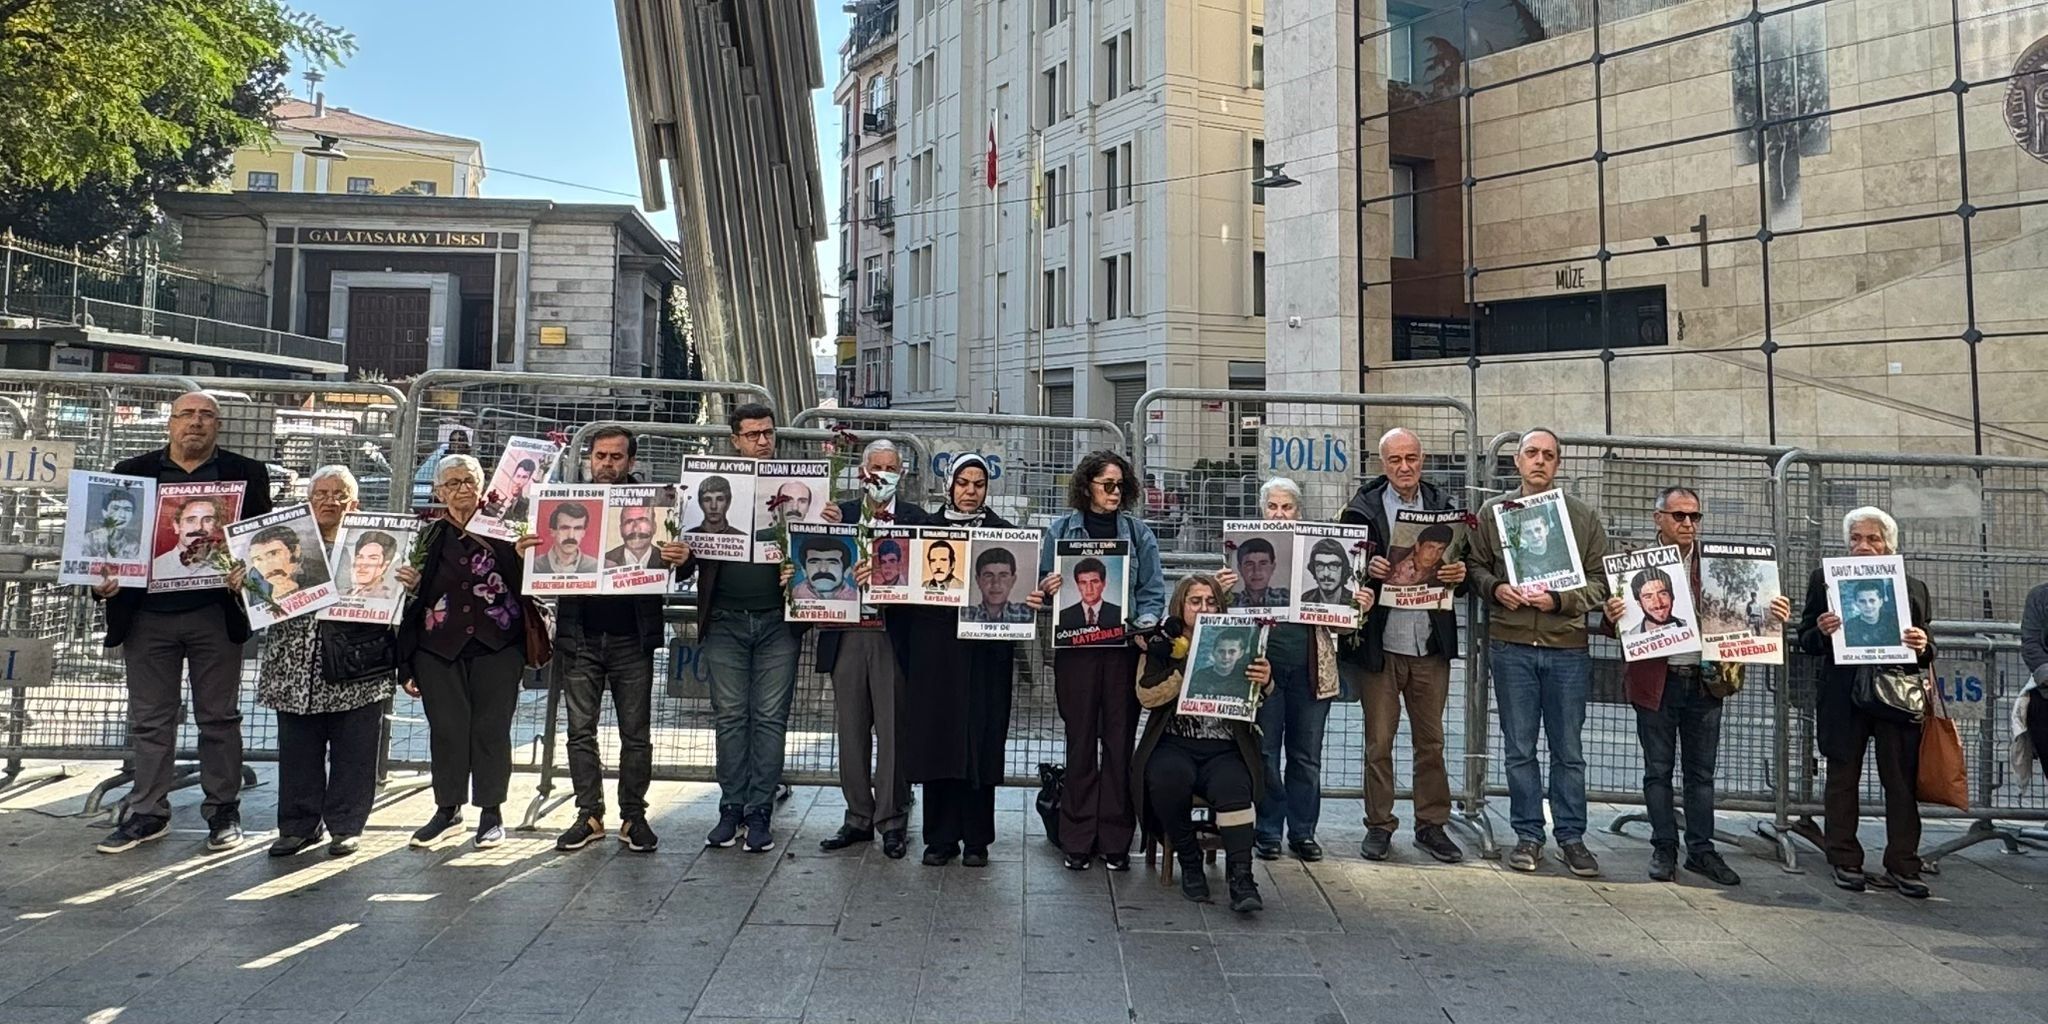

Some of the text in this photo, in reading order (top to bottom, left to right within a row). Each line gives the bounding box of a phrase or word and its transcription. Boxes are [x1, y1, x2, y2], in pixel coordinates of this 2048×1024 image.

[309, 230, 485, 246] GALATASARAY LİSESİ
[1556, 267, 1585, 290] MÜZE
[1269, 434, 1348, 472] POLİS
[0, 446, 58, 483] LİS
[687, 460, 717, 471] NEDİM
[759, 463, 828, 477] RIDVAN KARAKOÇ
[124, 479, 145, 487] EPE
[161, 483, 243, 495] KENAN BİLGİN
[573, 489, 604, 498] TOSUN
[610, 498, 643, 506] SEYHAN
[262, 508, 307, 527] KIRBAYIR
[344, 515, 417, 530] MURAT YILDIZ
[1399, 512, 1435, 522] SEYHAN
[790, 523, 858, 535] İBRAHİM DEMİR
[1263, 521, 1294, 530] DOĞAN
[1296, 525, 1365, 538] HAYRETTİN EREN
[890, 529, 910, 538] ÇELİK
[972, 530, 1039, 540] EYHAN DOĞAN
[692, 549, 743, 557] AYBEDİLDİ
[1703, 544, 1772, 556] ABDULLAH OLCAY
[1608, 549, 1679, 573] HASAN OCAK
[613, 573, 665, 589] KAYBEDİLDİ
[1395, 589, 1449, 606] KAYBEDİLDİ
[328, 606, 390, 620] KAYBEDİLDİ
[793, 609, 847, 620] KAYBEDİLDİ
[1300, 612, 1352, 624] KAYBEDİLDİ
[1056, 626, 1101, 639] GÖZALTINDA
[1072, 626, 1123, 645] KAYBEDİLDİ
[1628, 628, 1695, 658] KAYBEDİLDİ
[1719, 643, 1778, 659] KAYBEDİLDİ
[1938, 670, 1983, 703] LİS
